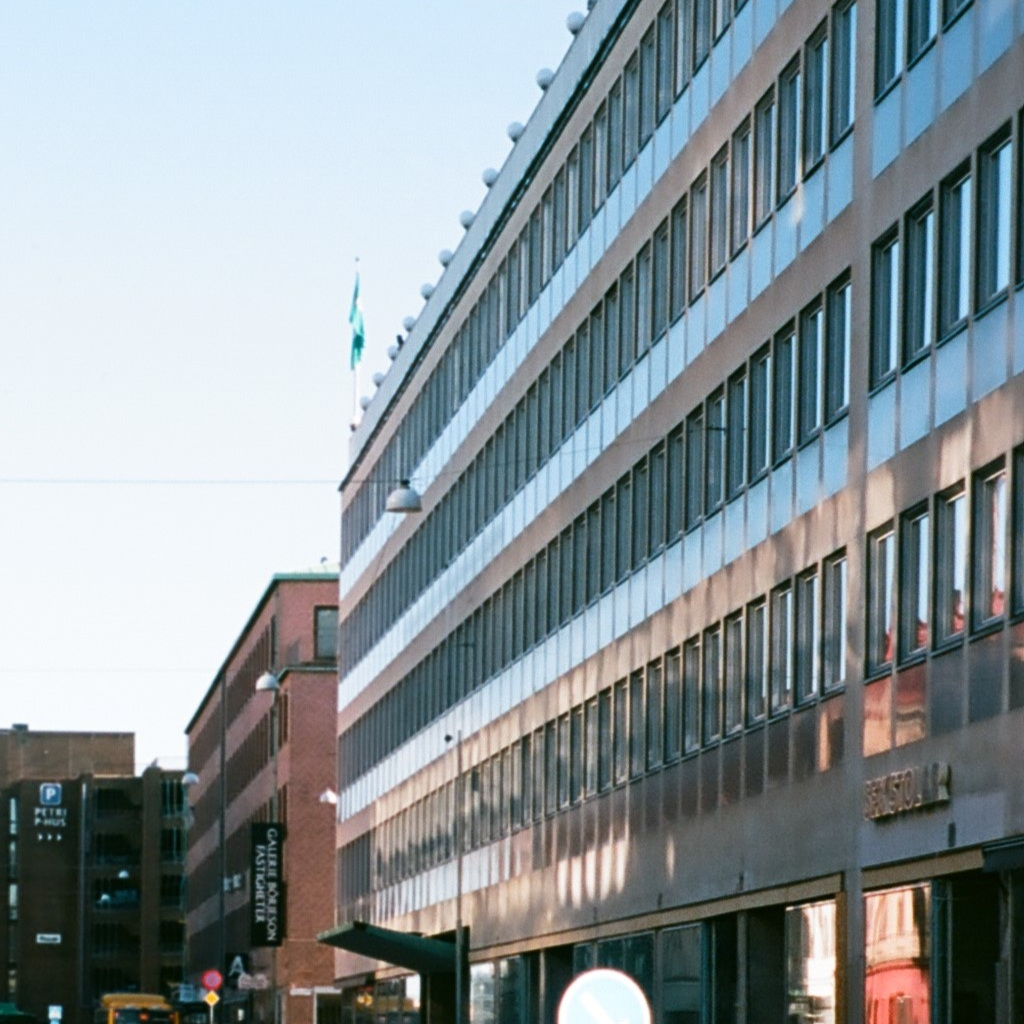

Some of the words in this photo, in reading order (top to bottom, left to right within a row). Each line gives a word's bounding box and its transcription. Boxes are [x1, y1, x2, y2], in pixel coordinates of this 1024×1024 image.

[46, 788, 56, 800] P
[35, 808, 67, 816] PETRI
[267, 828, 277, 877] GALERIE
